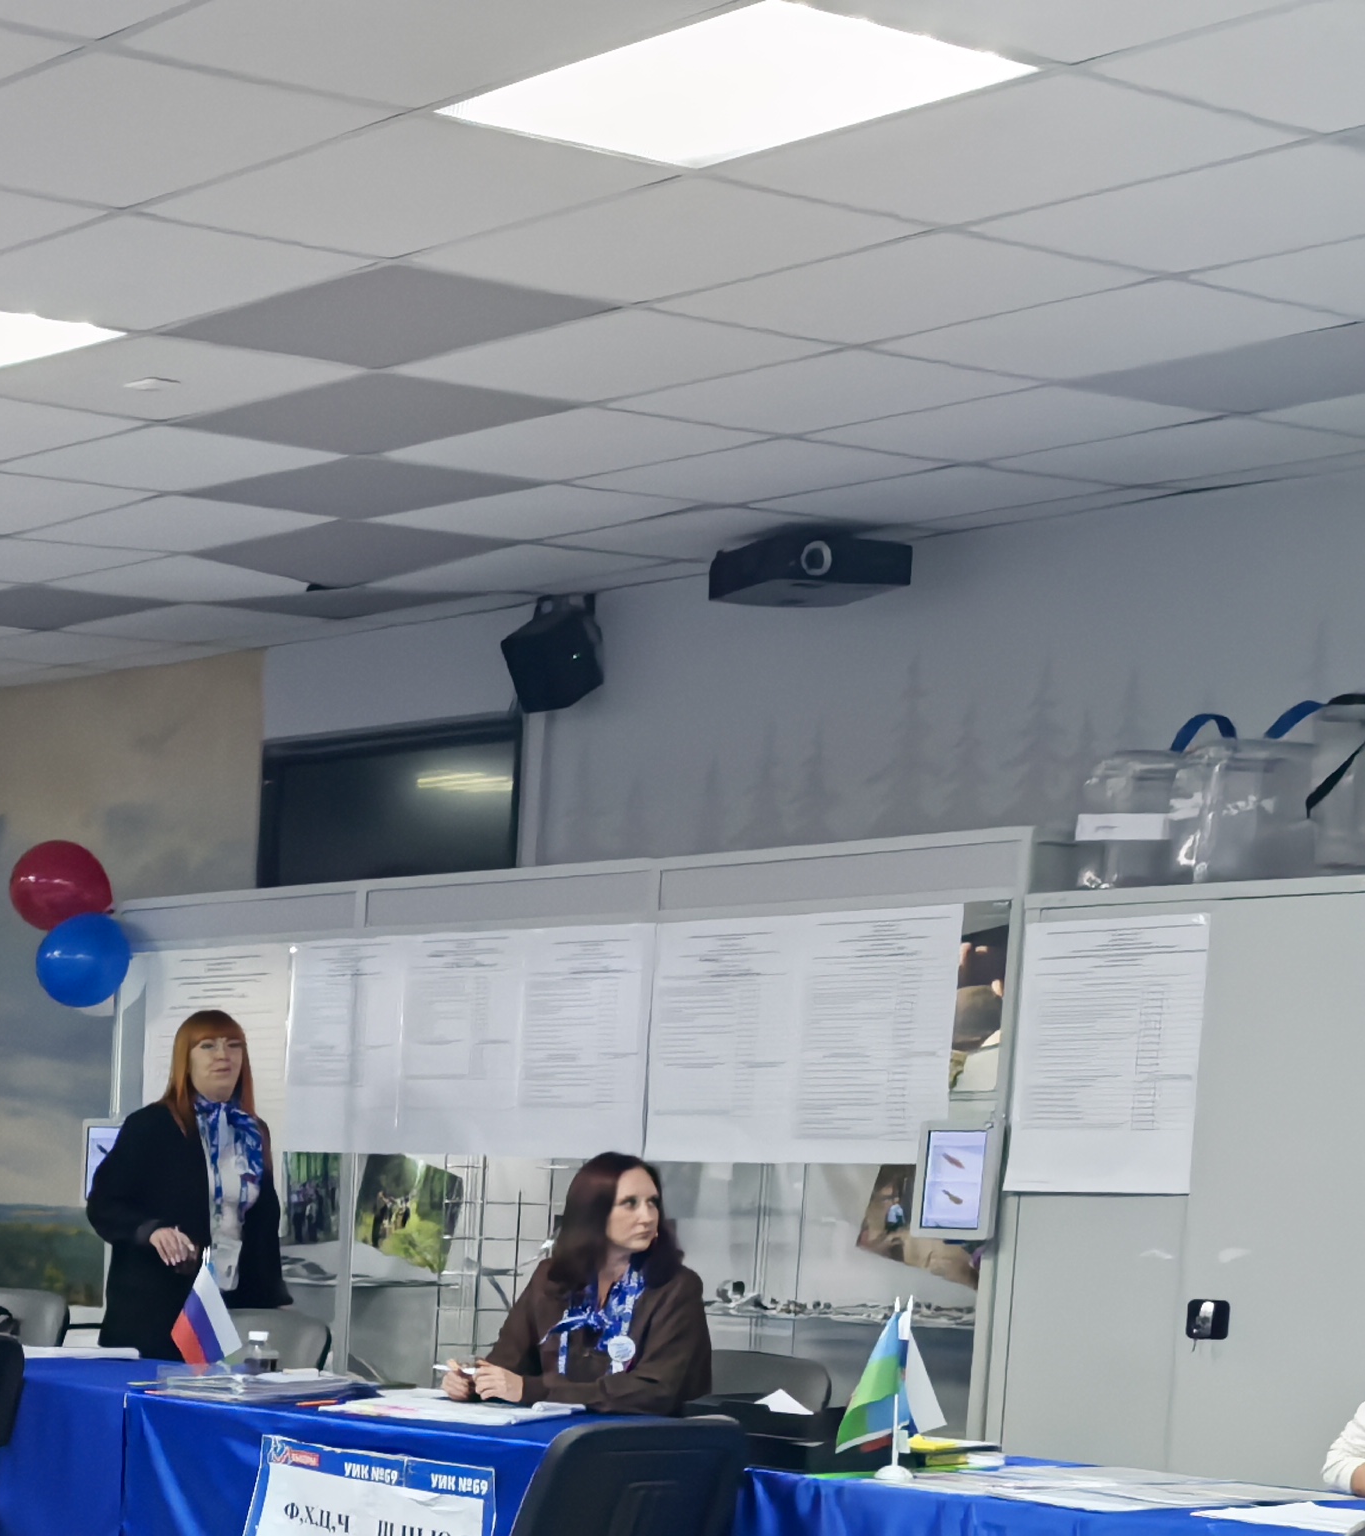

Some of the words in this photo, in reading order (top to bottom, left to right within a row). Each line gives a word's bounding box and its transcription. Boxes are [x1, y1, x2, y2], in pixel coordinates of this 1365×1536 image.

[344, 1462, 369, 1480] УИК
[371, 1466, 400, 1485] №69
[430, 1472, 456, 1491] УИК
[457, 1477, 489, 1496] №69
